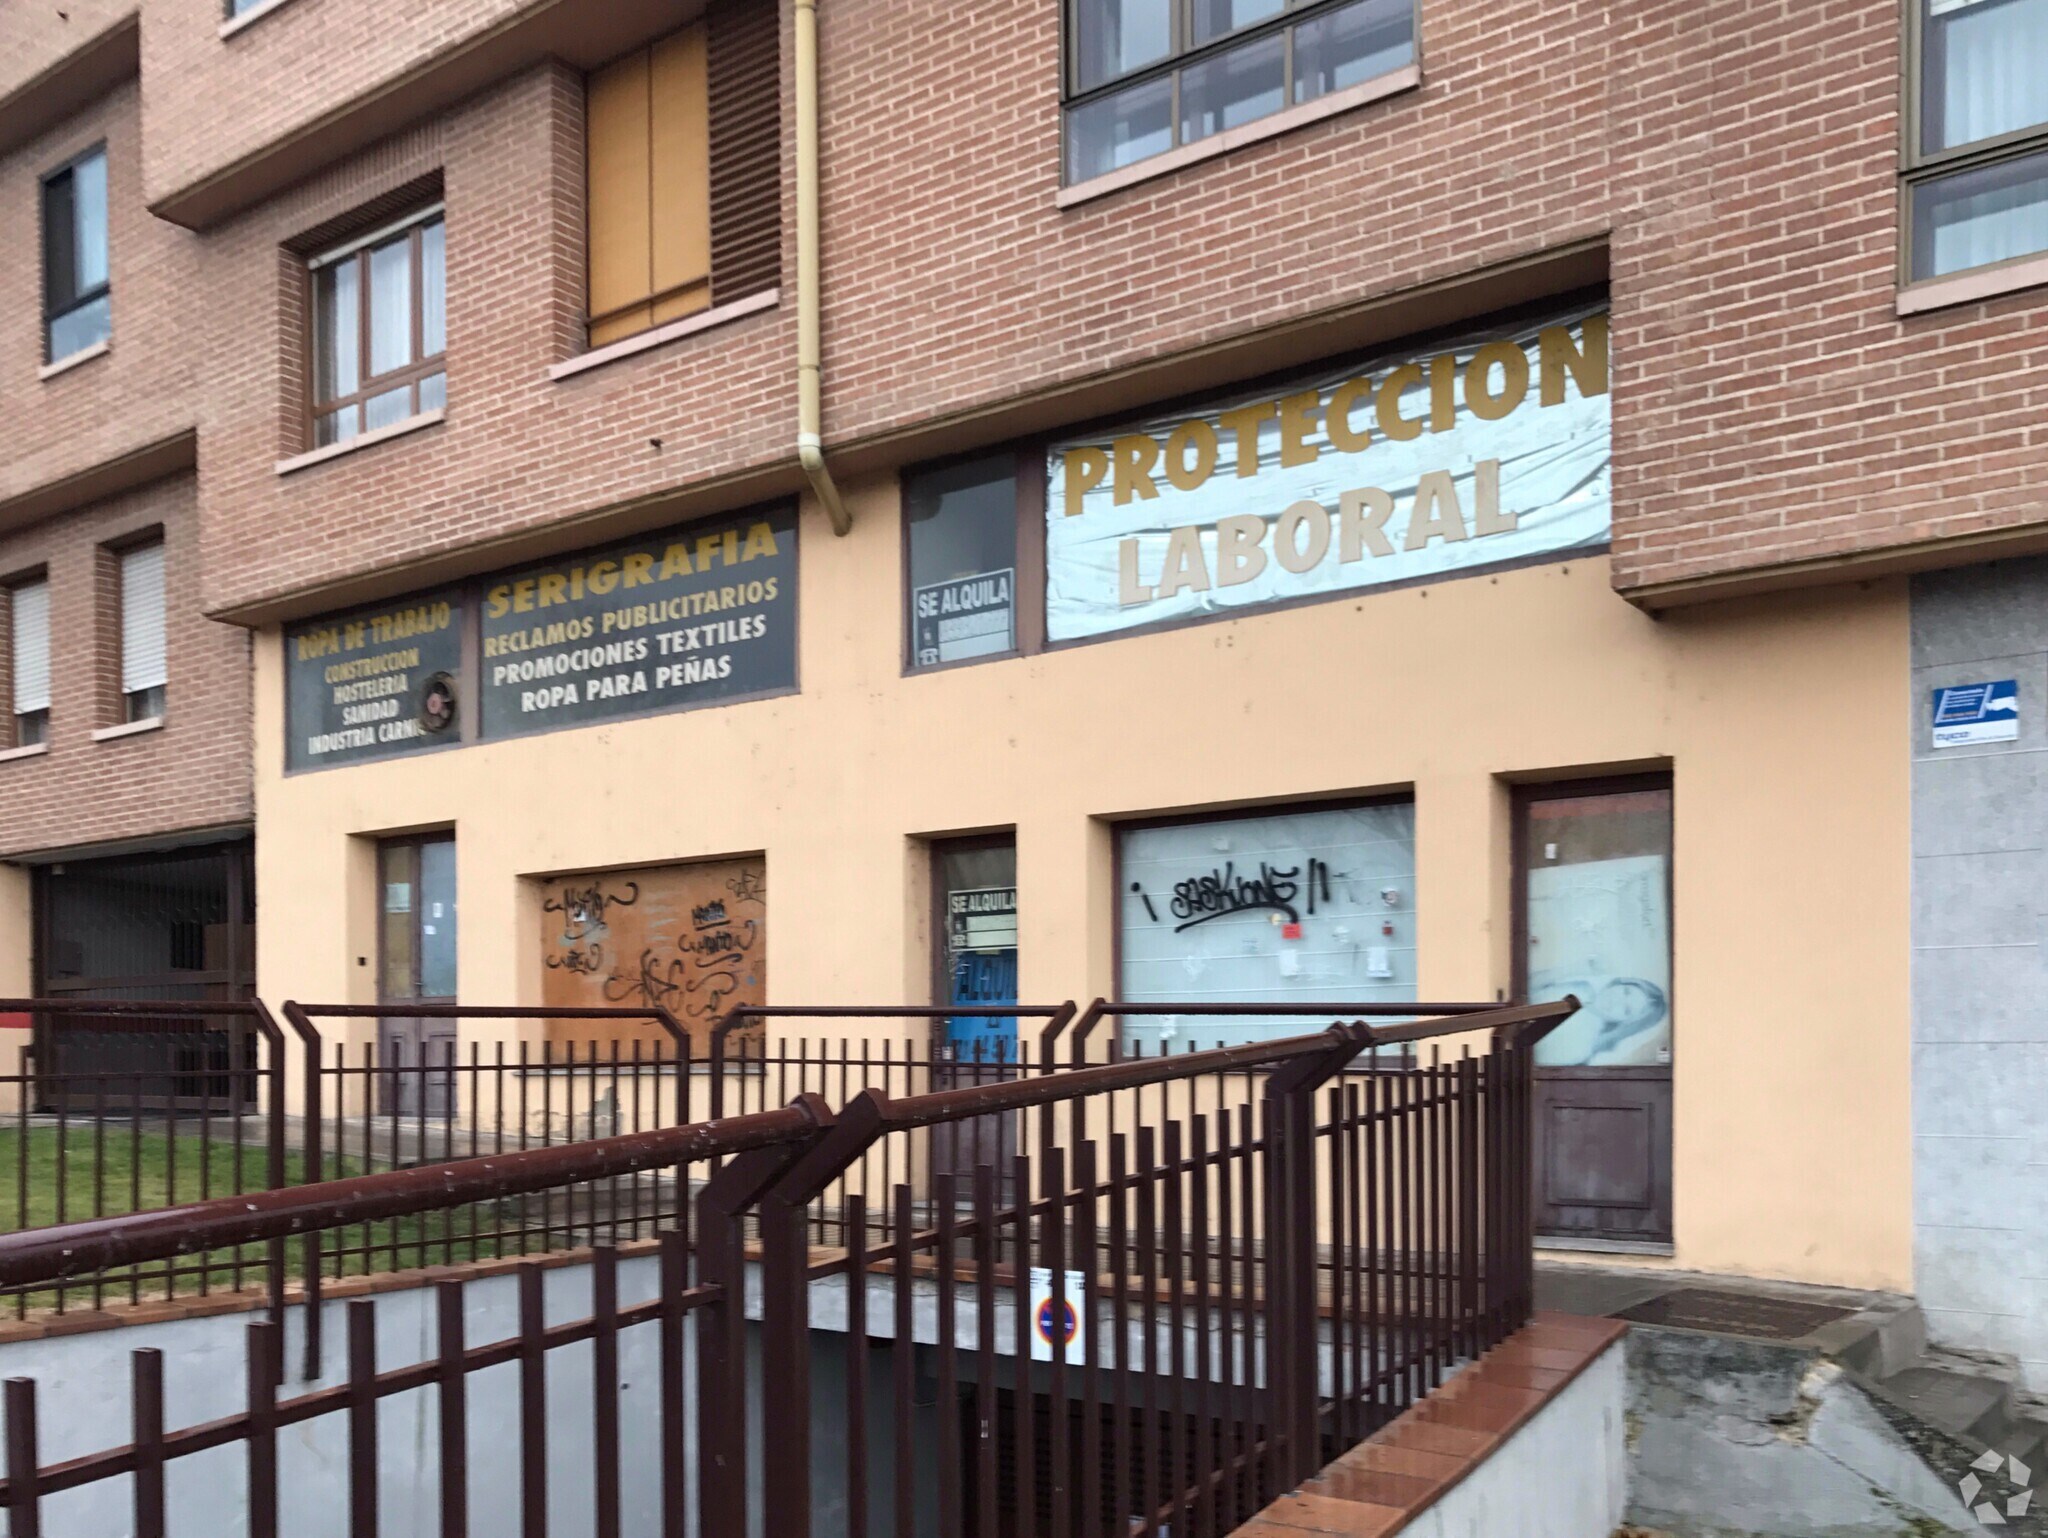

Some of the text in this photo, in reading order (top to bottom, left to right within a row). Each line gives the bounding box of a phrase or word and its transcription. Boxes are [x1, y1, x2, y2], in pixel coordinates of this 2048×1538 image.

[1064, 317, 1609, 517] PROTECCION
[1119, 457, 1518, 606] LABORAL
[487, 522, 779, 619] SERIGRAFIA
[918, 577, 1009, 619] SE ALQUILA
[298, 602, 450, 662] ROPA DE TRABAJO
[485, 577, 778, 657] RECLAMOS PUBLICITARIOS
[325, 647, 420, 684] CONSTRUCCION
[494, 614, 767, 686] PROMOCIONES TEXTILES
[333, 673, 409, 705] HOSTELERIA
[342, 699, 400, 725] SANIDAD
[521, 654, 732, 712] ROPA PARA PEÑAS
[308, 726, 376, 755] INDUSTRIA
[951, 891, 1016, 914] SE ALQUILA
